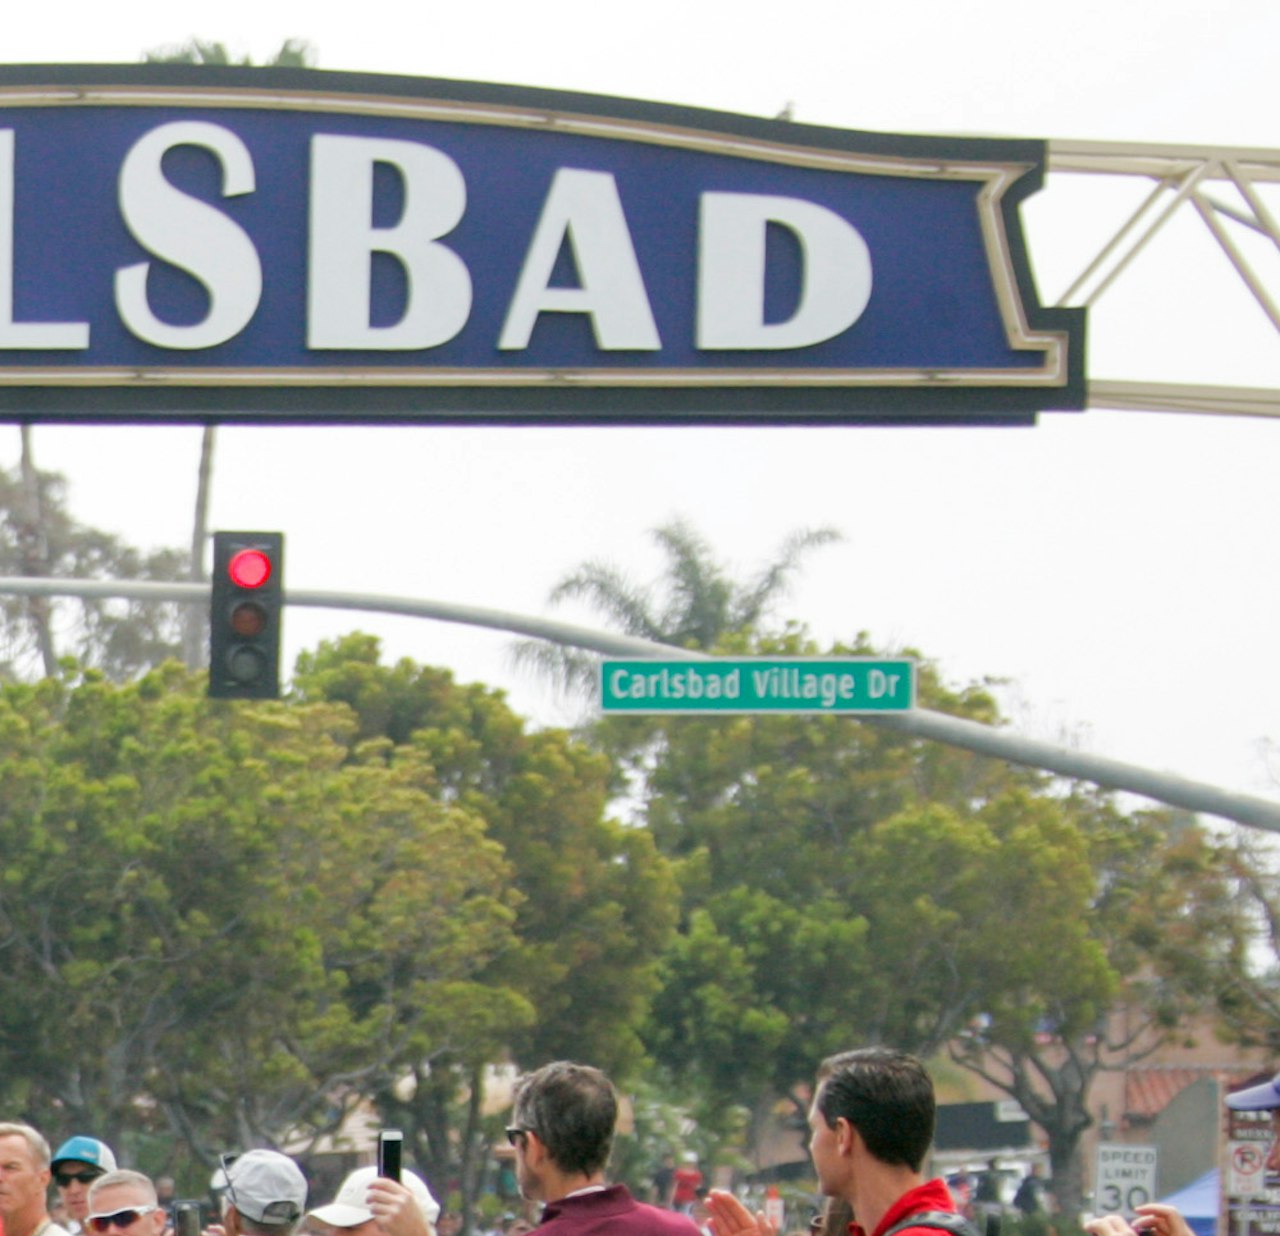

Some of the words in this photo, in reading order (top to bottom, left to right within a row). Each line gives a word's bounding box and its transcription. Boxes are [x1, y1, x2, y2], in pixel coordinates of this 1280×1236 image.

[609, 668, 740, 699] Carlsbad
[752, 667, 855, 707] Village
[866, 669, 901, 698] Dr
[1101, 1151, 1155, 1164] SPEED
[1104, 1168, 1149, 1179] LIMIT
[1101, 1184, 1150, 1212] 30
